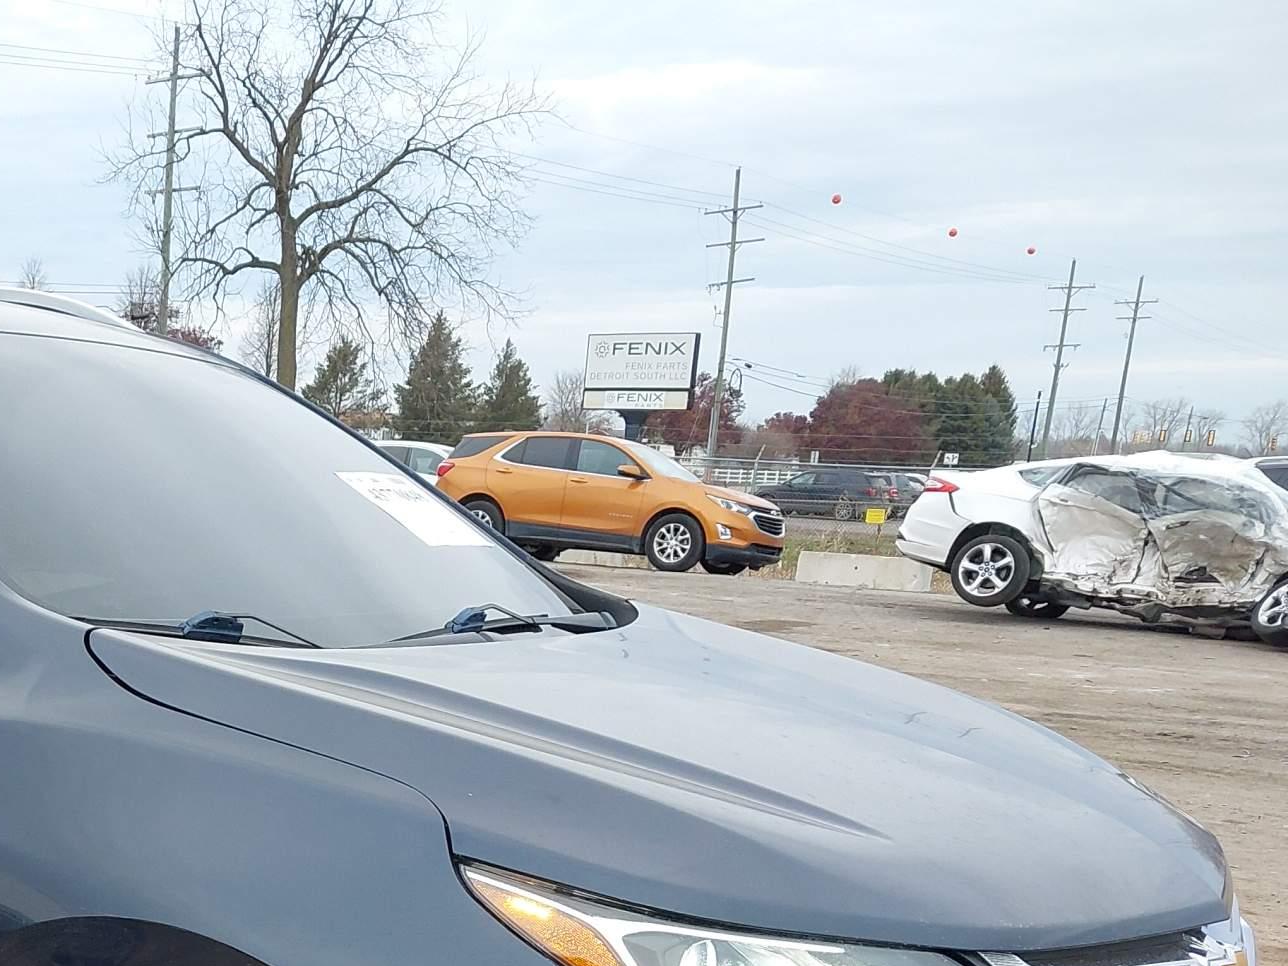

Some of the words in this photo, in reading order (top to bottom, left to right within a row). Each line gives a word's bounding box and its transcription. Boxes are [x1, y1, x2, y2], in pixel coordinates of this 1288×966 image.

[612, 341, 686, 356] FENIX
[625, 361, 654, 370] FENIX
[656, 361, 688, 370] PARTS
[590, 372, 630, 381] DETROIT
[631, 372, 666, 381] SOUTH
[669, 371, 688, 381] LLC
[616, 392, 664, 403] FENIX
